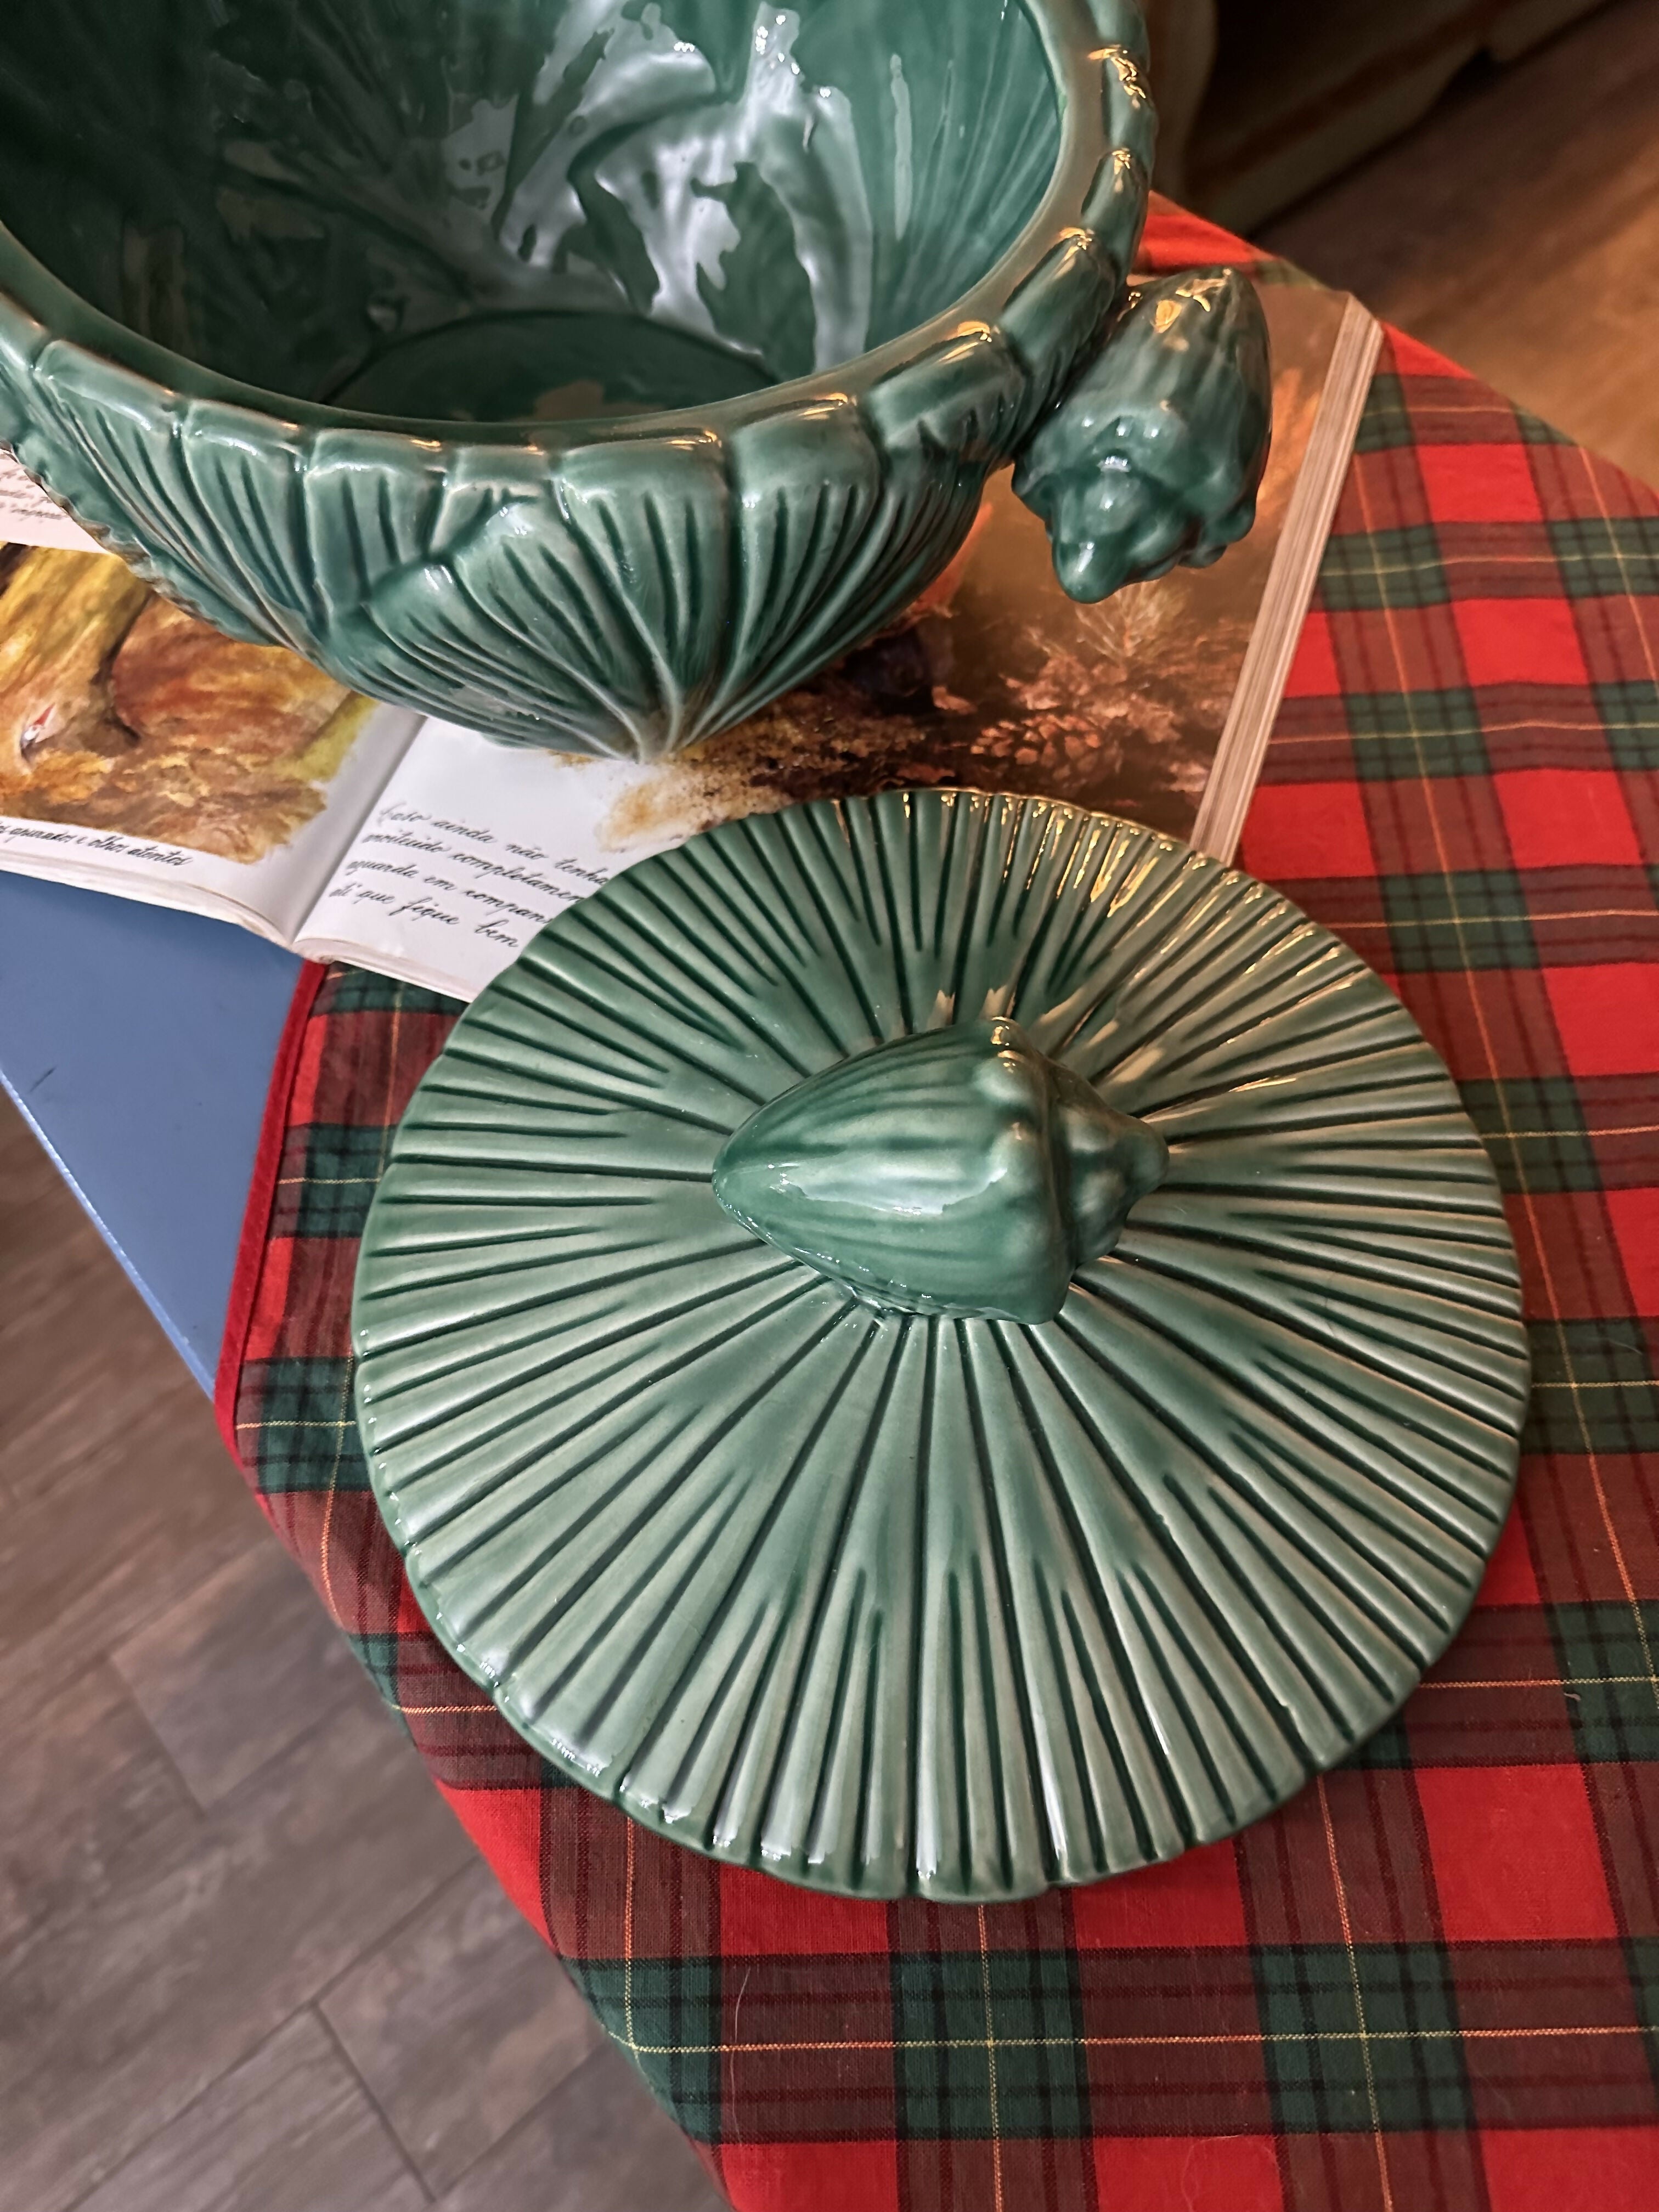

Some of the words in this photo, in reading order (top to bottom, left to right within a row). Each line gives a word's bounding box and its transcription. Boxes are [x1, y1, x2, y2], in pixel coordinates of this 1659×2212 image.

[88, 830, 129, 853] olhos
[127, 845, 194, 866] atentos
[430, 820, 496, 843] ainda
[506, 844, 549, 860] não
[554, 858, 609, 886] tenha
[345, 860, 419, 878] aguarda
[424, 876, 456, 890] em
[353, 890, 396, 905] que
[388, 896, 460, 925] fique
[474, 918, 519, 947] bem
